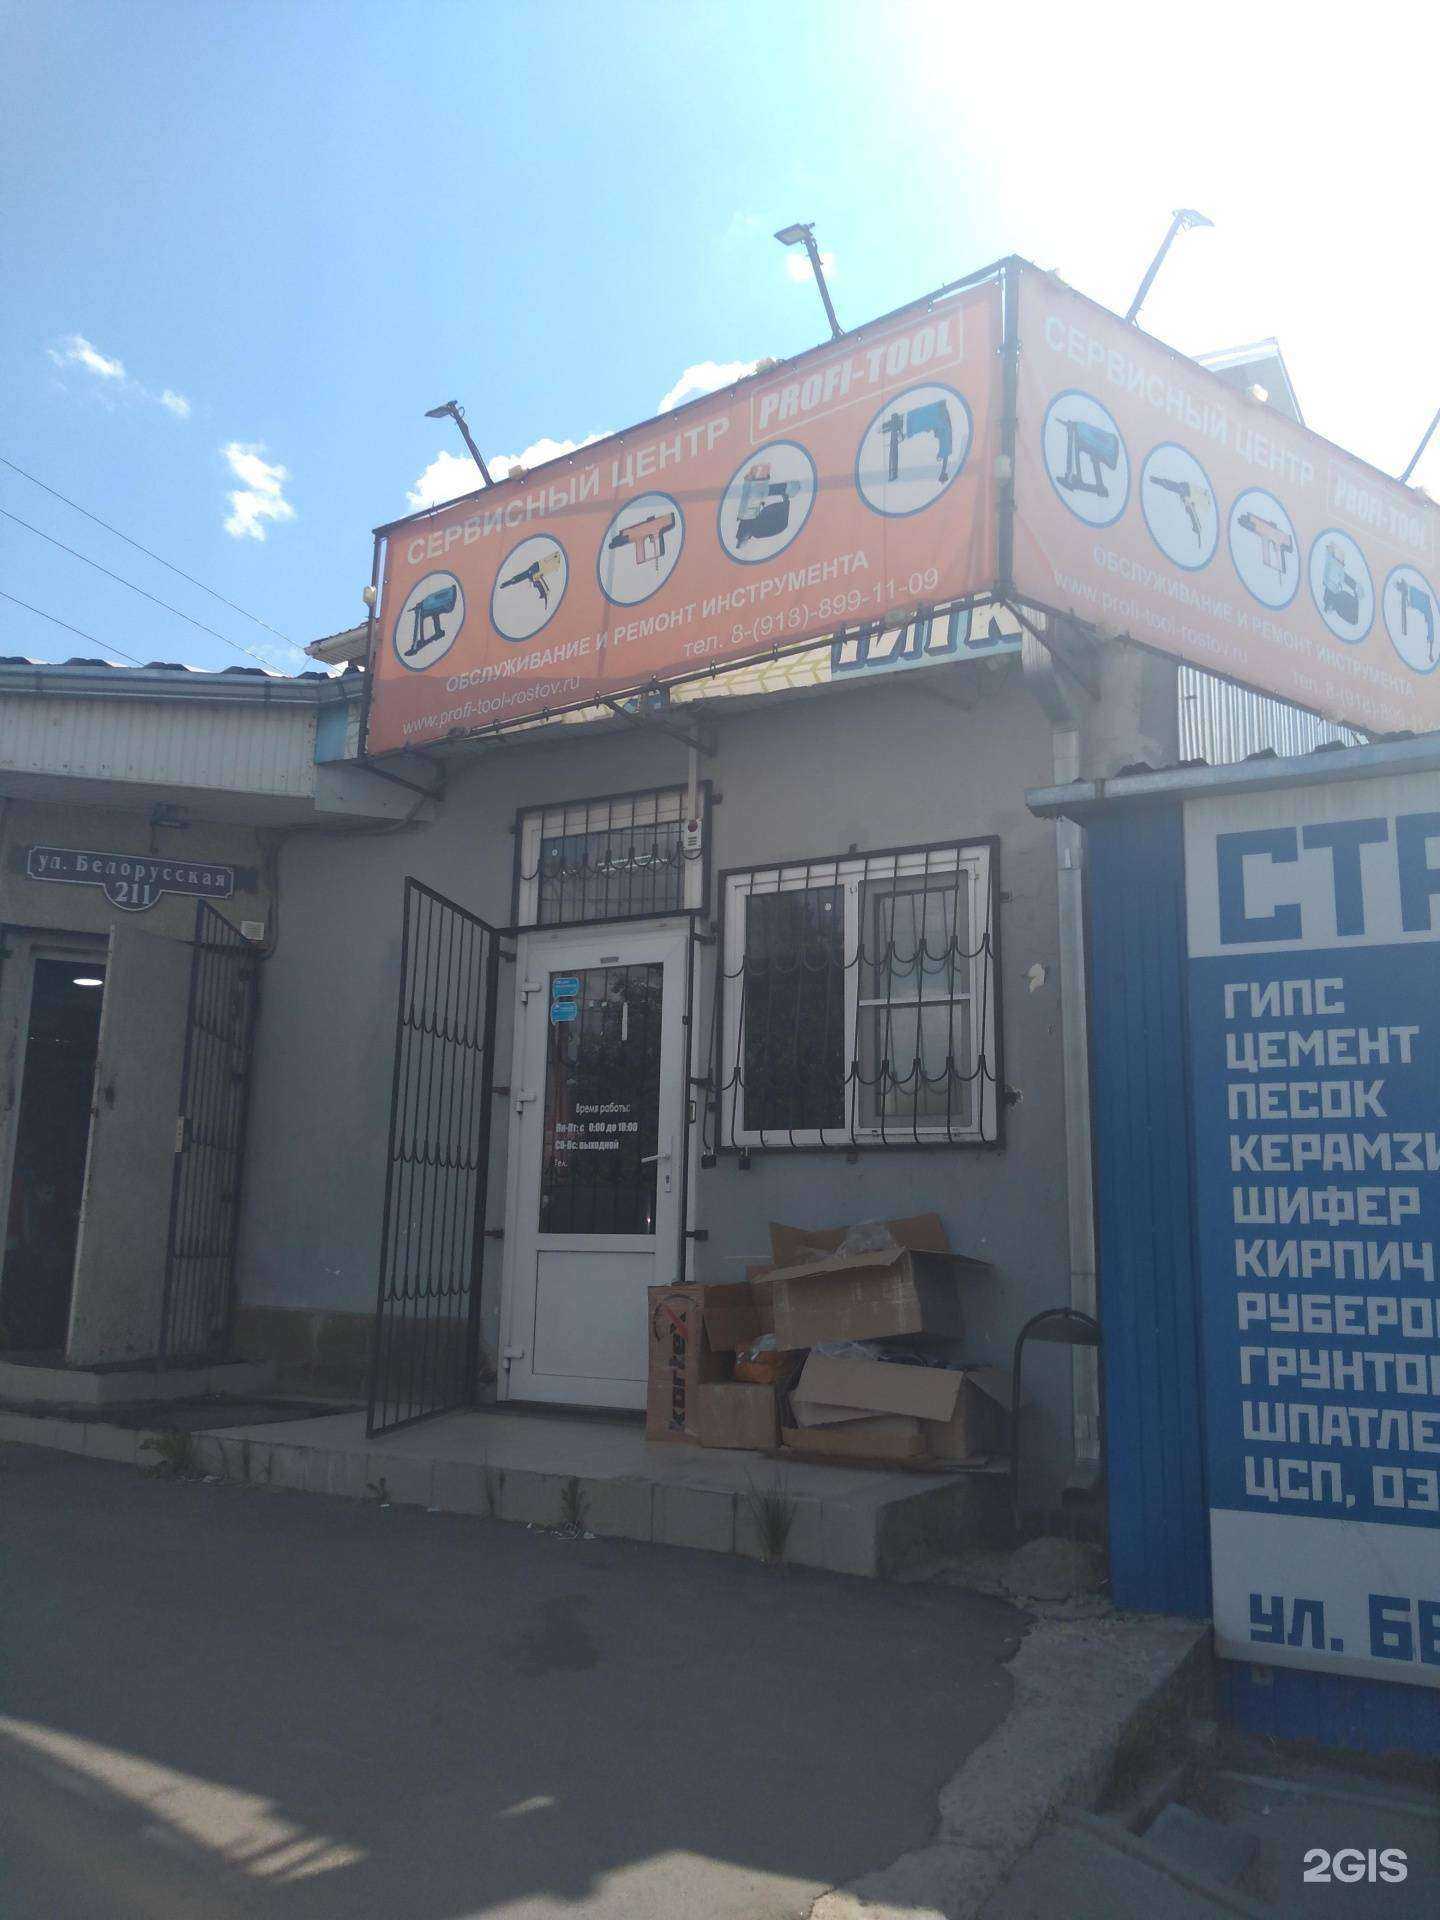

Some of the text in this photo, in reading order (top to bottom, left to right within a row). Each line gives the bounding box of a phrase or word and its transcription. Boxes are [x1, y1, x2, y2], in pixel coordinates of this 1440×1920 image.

[757, 317, 956, 430] PROFI-TOOL
[1043, 313, 1315, 484] СЕРВИСНЫЙ ЦЕНТР
[406, 416, 730, 566] СЕРВИСНЫЙ ЦЕНТР
[1092, 543, 1234, 623] ОБСЛУЖИВАНИЕ
[445, 550, 870, 692] ОБСЛУЖИВАНИЕ И РЕМОНТ ИНСТРУМЕНТА
[682, 567, 940, 658] тел. 8-(918)-899-11-09
[401, 675, 581, 735] www.profi-tool-rostov.ru
[38, 853, 226, 887] ул. Белорусская
[115, 881, 150, 905] 211
[1223, 977, 1345, 1019] ГИПС
[1225, 1025, 1420, 1073] ЦЕМЕНТ
[1227, 1079, 1388, 1120] ПЕСОК
[1232, 1185, 1421, 1226] ШИФЕР
[1234, 1239, 1435, 1282] КИРПИЧ
[1236, 1291, 1440, 1339] РУБЕРО
[1239, 1346, 1440, 1397] ГРУНТО
[1242, 1400, 1440, 1453] ШПАТЛЕ
[1244, 1455, 1356, 1509] ЦСП,
[1249, 1592, 1344, 1652] УЛ.
